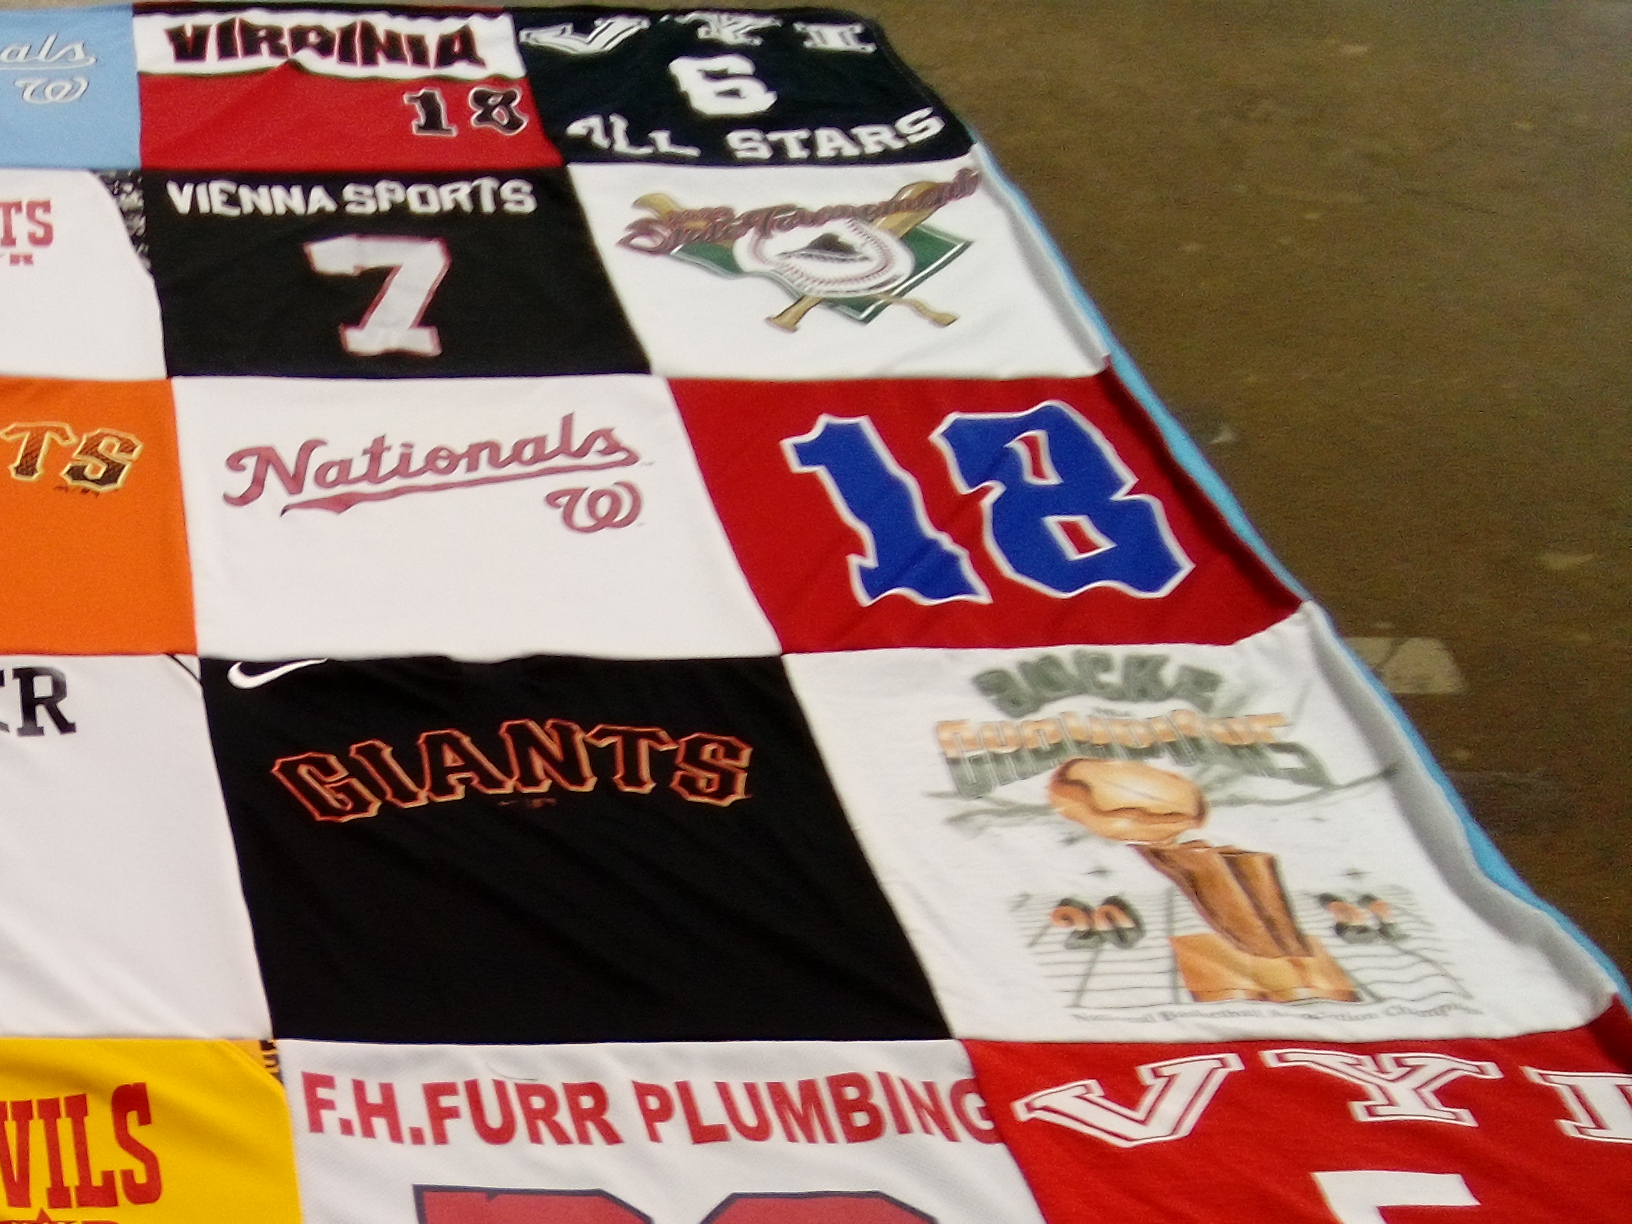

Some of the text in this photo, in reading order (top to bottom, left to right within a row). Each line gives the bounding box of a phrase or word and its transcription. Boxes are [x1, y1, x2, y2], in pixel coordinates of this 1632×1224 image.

[404, 86, 530, 137] 18
[669, 53, 778, 116] 6
[567, 107, 946, 160] ALL STARS
[166, 177, 537, 216] VIENNA SPORTS
[304, 233, 450, 358] 7
[223, 411, 639, 517] Nationals
[779, 399, 1197, 607] 18
[271, 718, 755, 822] GIANTS
[632, 1071, 1006, 1146] PLUMBING
